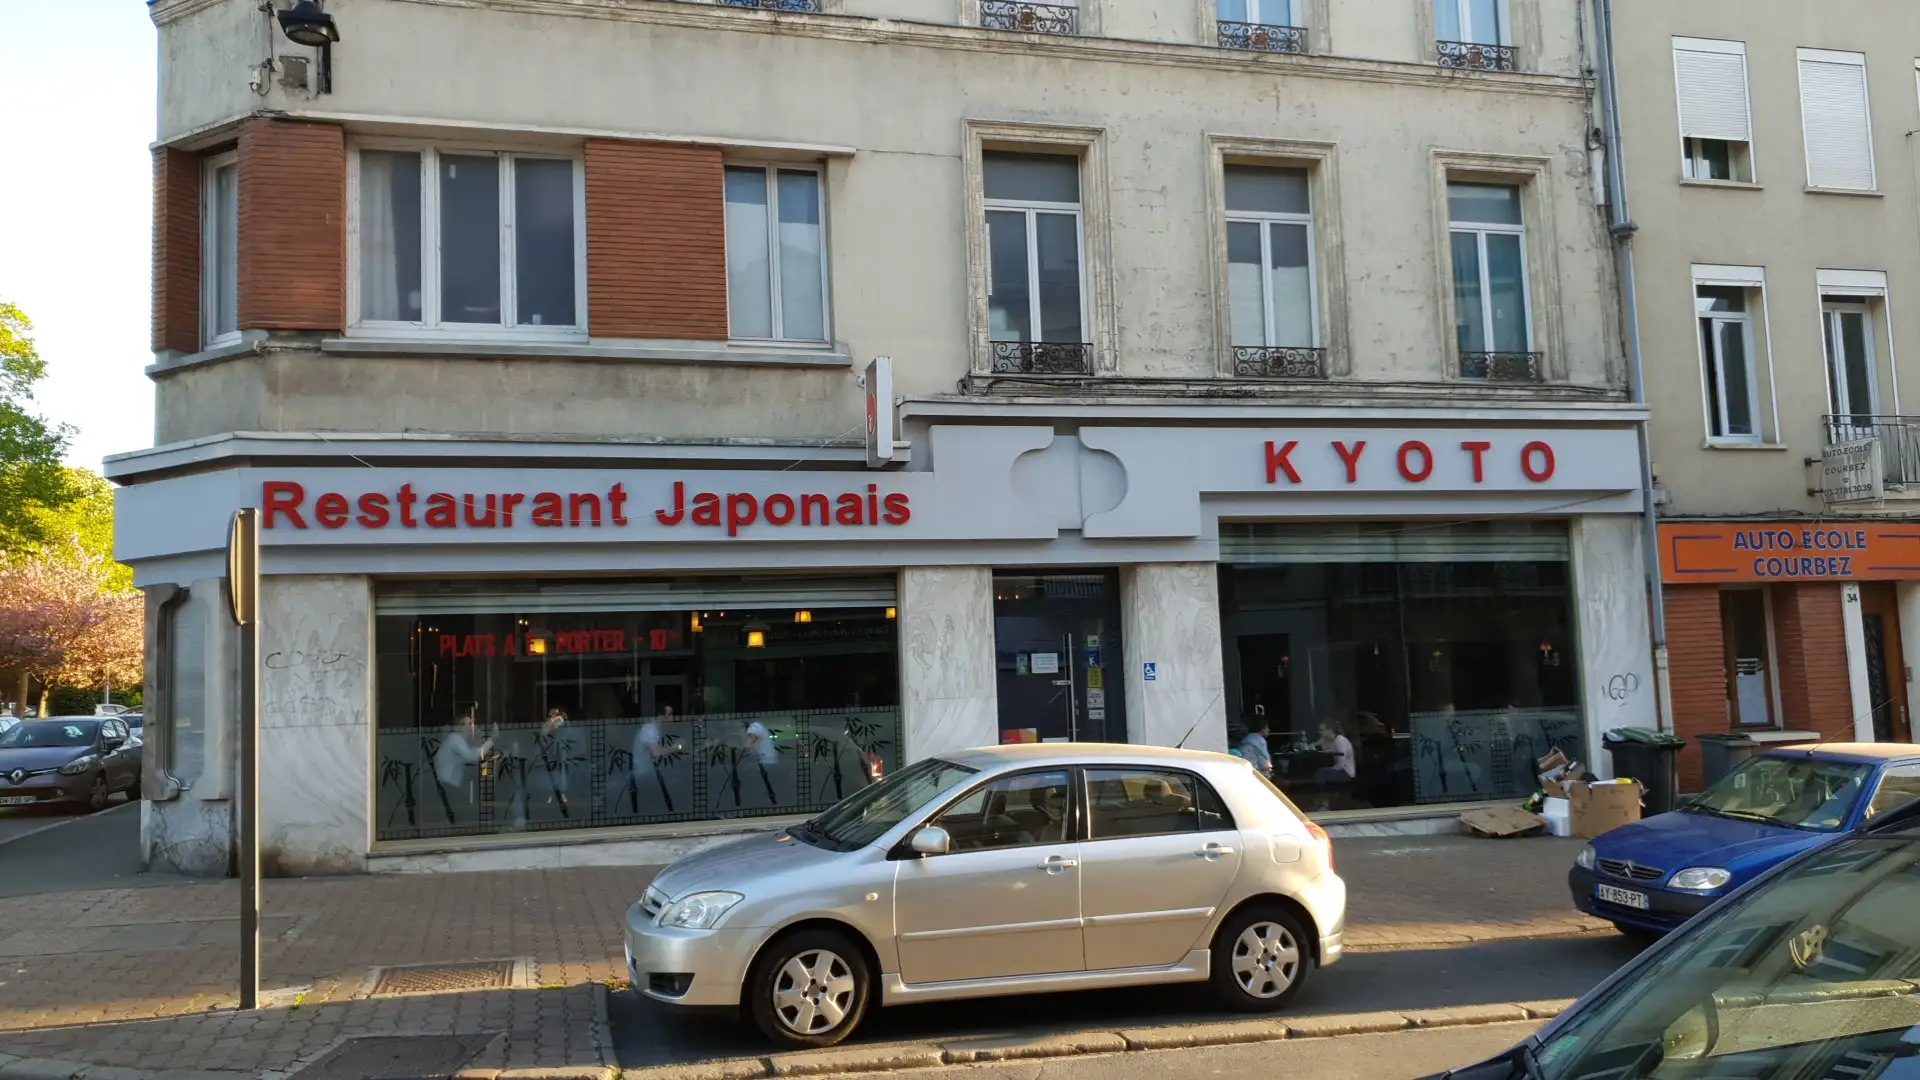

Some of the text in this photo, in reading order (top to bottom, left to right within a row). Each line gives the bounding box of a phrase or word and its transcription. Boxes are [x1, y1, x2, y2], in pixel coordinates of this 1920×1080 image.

[1264, 440, 1556, 484] KYOTO
[1824, 462, 1866, 475] COURBEZ
[262, 480, 912, 537] Restaurant Japonais
[1732, 530, 1867, 550] AUTO ECOLE
[1752, 556, 1853, 577] COURBEZ
[1846, 592, 1858, 603] 34
[440, 633, 498, 658] PLATS
[503, 633, 517, 657] A
[1600, 887, 1642, 907] AY-853-PT
